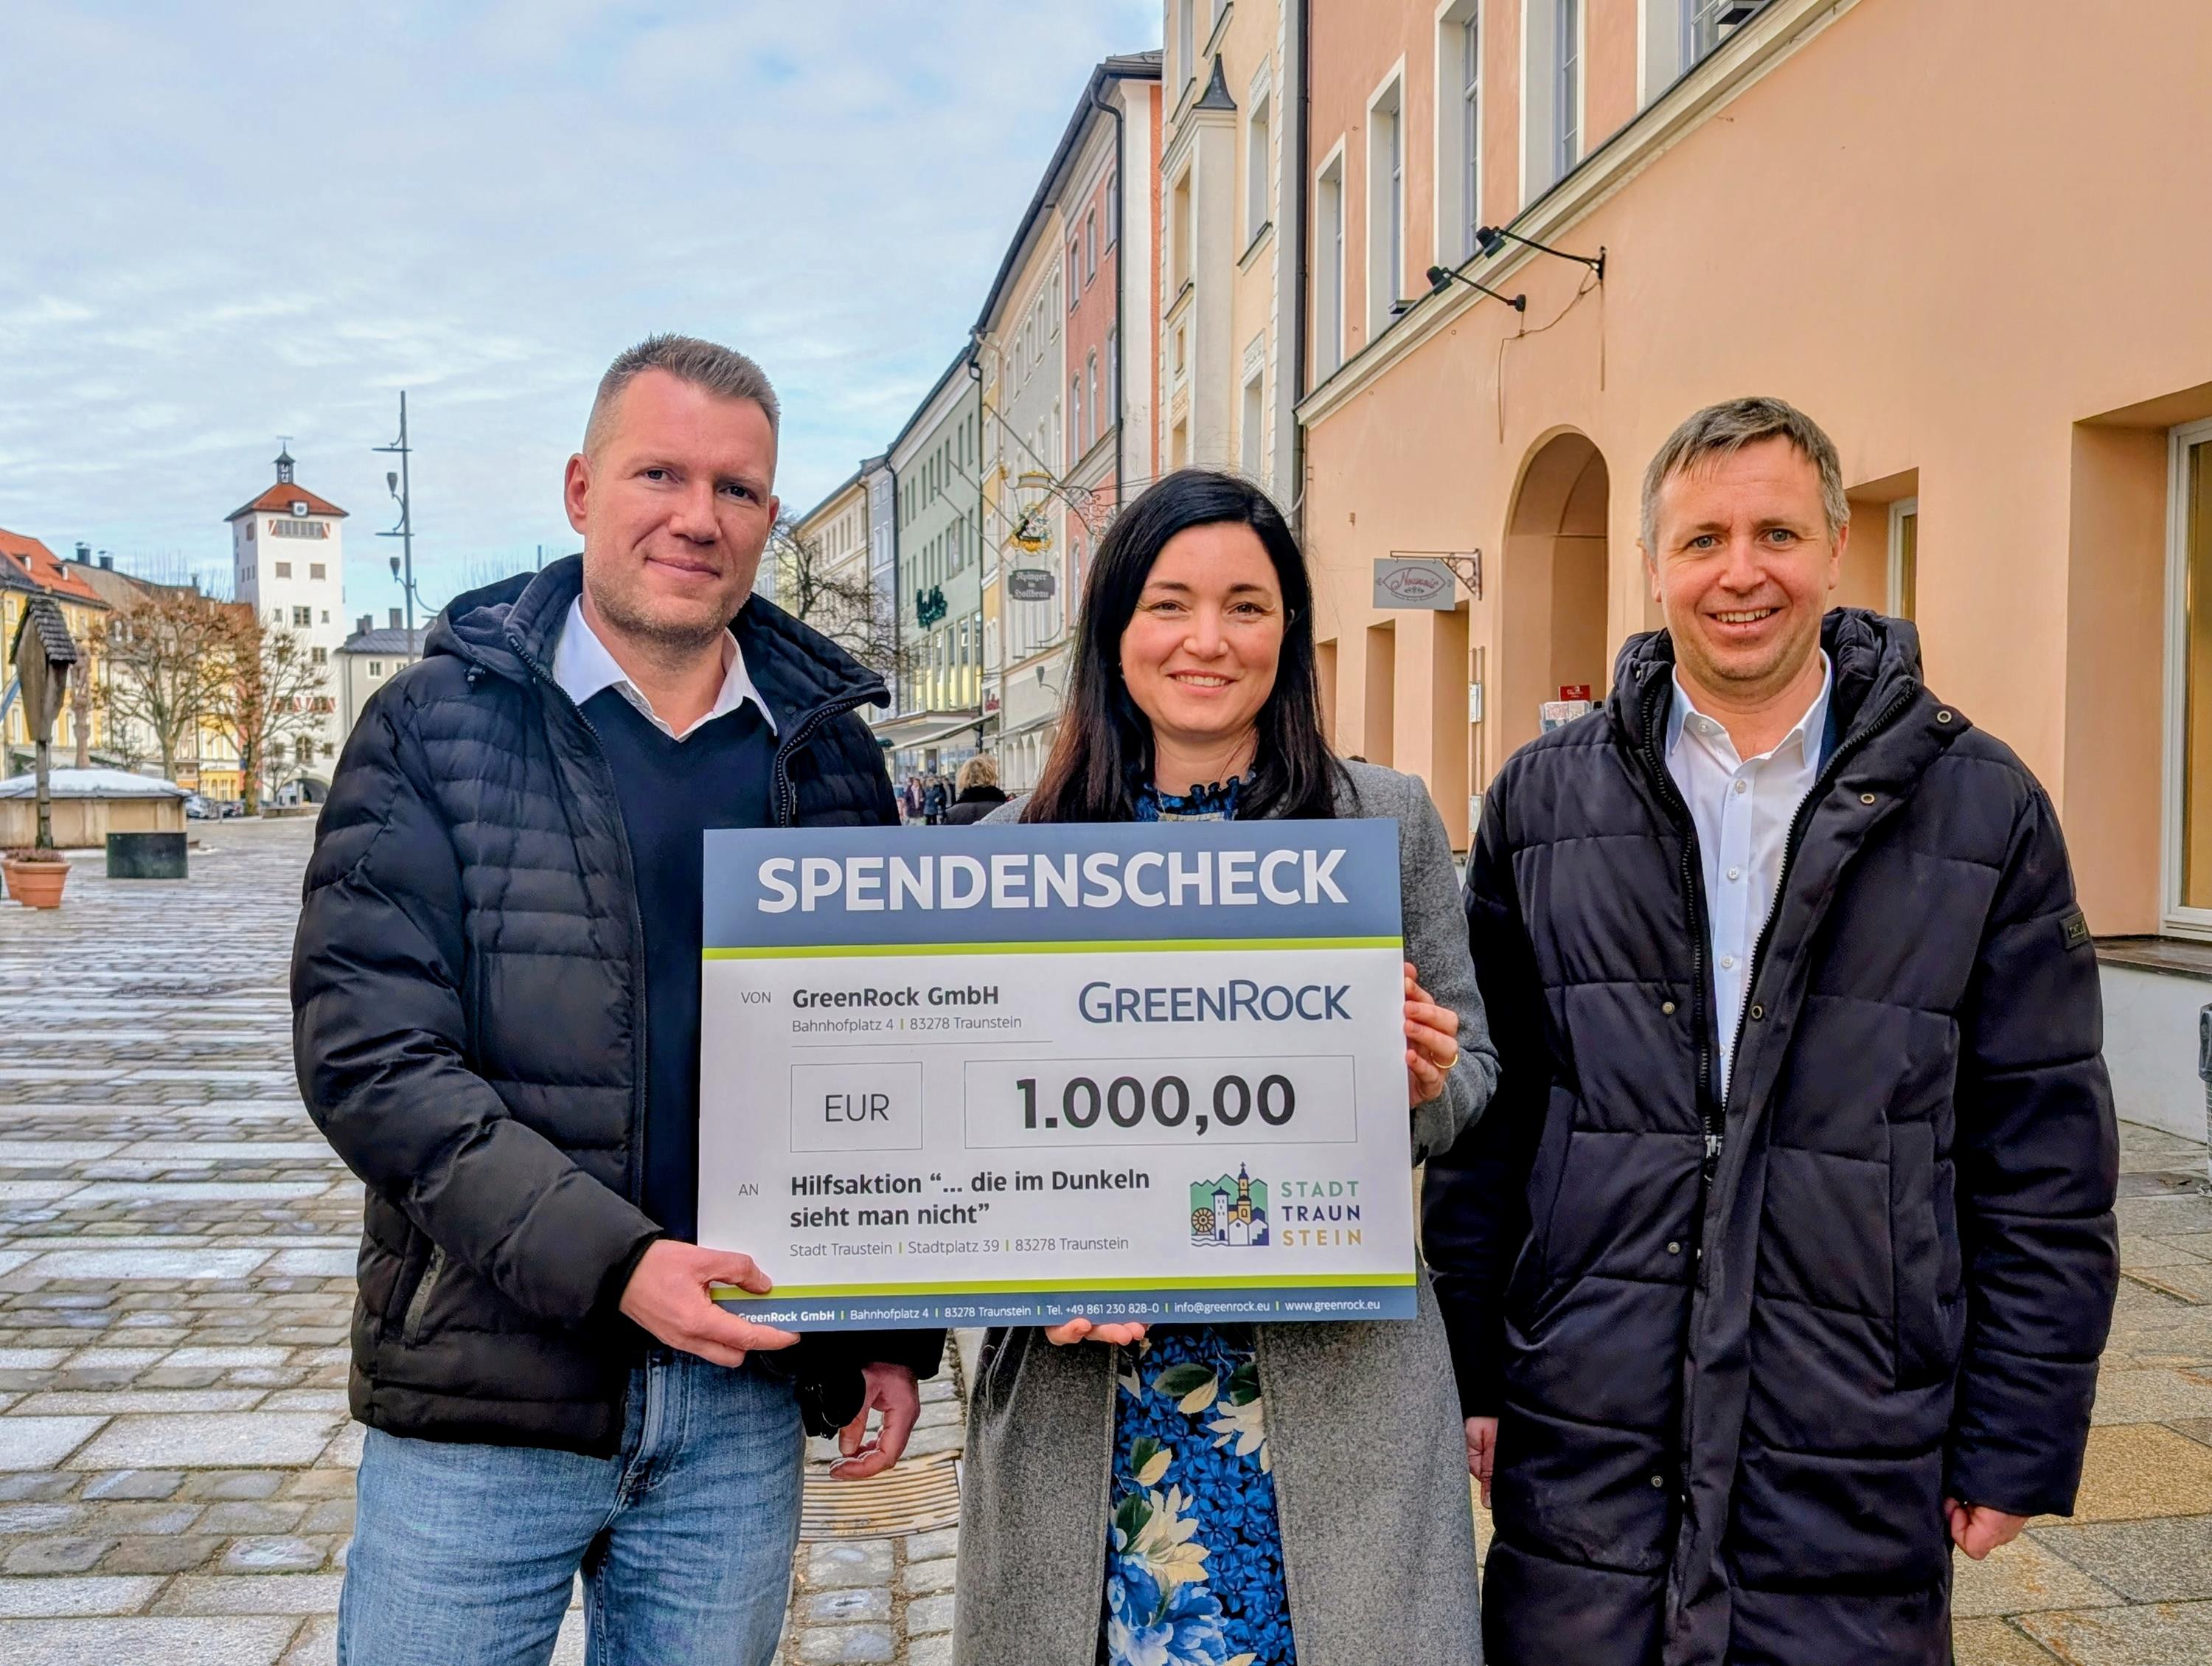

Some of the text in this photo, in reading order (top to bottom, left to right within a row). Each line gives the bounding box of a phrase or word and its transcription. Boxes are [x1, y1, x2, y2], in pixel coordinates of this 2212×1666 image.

[758, 850, 1349, 913] SPENDENSCHECK
[741, 992, 771, 1003] VON
[793, 986, 998, 1007] GreenRock GmbH
[793, 1016, 1021, 1032] Bahnhofplatz 4 83278 Traunstein
[826, 1094, 889, 1122] EUR
[1017, 1075, 1295, 1136] 1.000,00
[739, 1184, 758, 1195] AN
[792, 1174, 921, 1195] Hilfsaktion
[972, 1172, 1006, 1192] die
[1016, 1171, 1043, 1190] im
[1053, 1169, 1149, 1190] Dunkeln
[1281, 1181, 1358, 1197] STADT
[790, 1207, 849, 1227] sieht
[859, 1209, 908, 1225] man
[1282, 1205, 1360, 1221] TRAUN
[790, 1237, 1128, 1256] Stadt Traustein Stadtplatz 39 83278 Traunstein
[1283, 1229, 1361, 1246] STEIN
[801, 1311, 834, 1321] GmbH
[851, 1309, 919, 1320] Bahnhofplatz
[922, 1308, 928, 1317] 4
[945, 1308, 975, 1317] 83278
[978, 1306, 1031, 1316] Traunstein
[1047, 1305, 1062, 1315] Tel.
[1066, 1305, 1083, 1314] +49
[1087, 1305, 1103, 1314] 861
[1107, 1304, 1125, 1313] 230
[1129, 1303, 1159, 1313] 828-0
[1175, 1302, 1270, 1313] info@greenrock.eu
[1285, 1299, 1380, 1312] www.greenrock.eu
